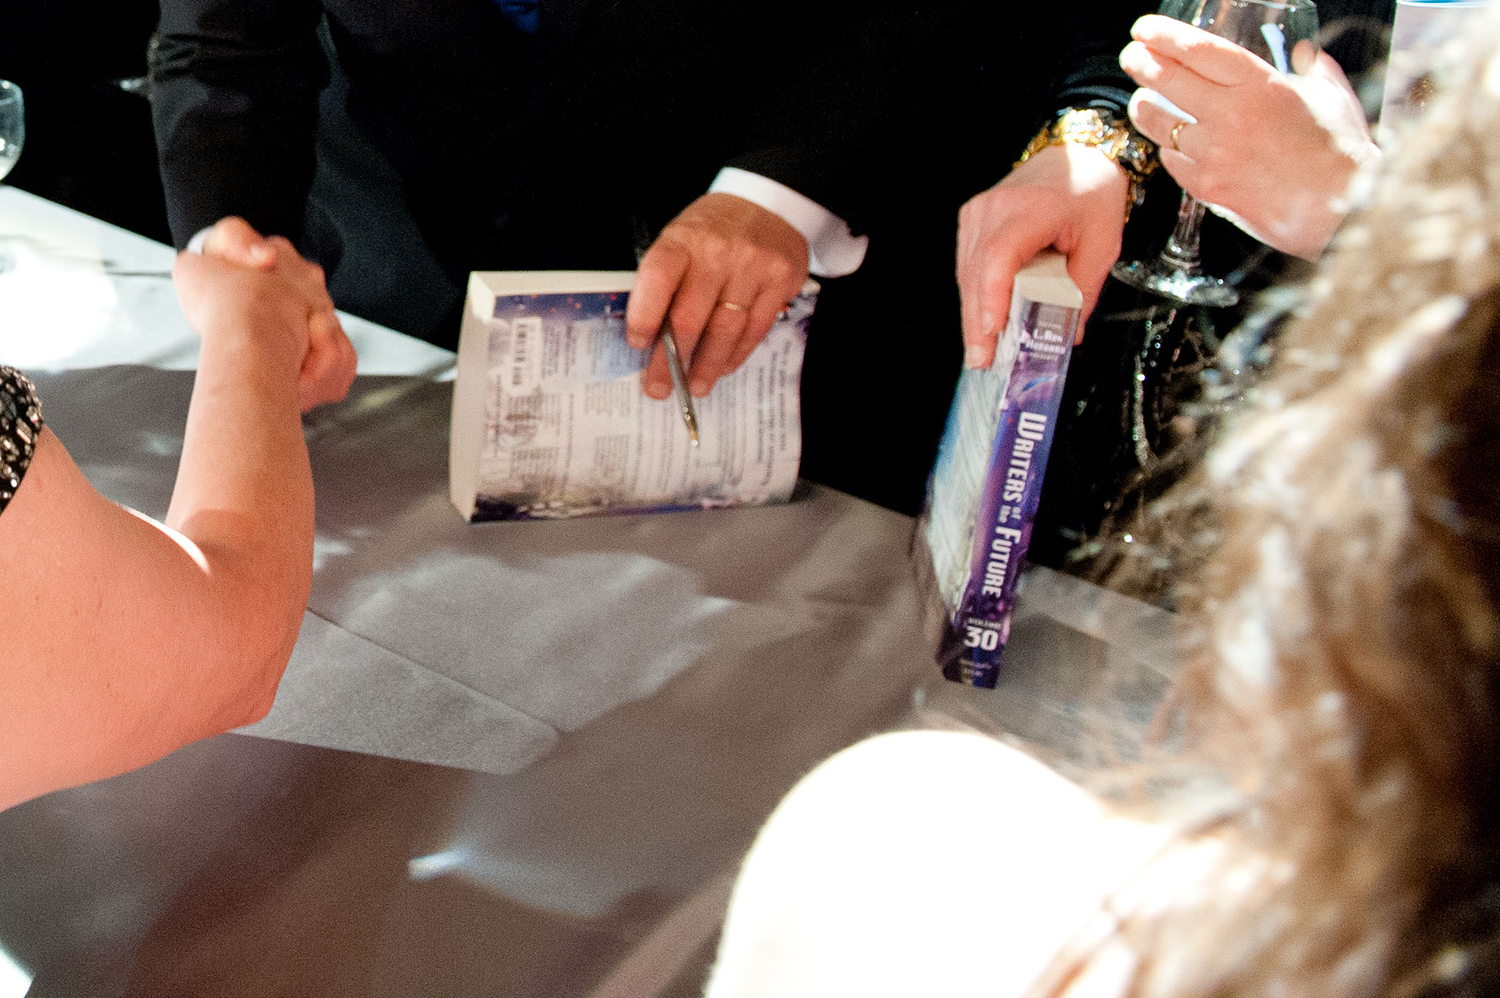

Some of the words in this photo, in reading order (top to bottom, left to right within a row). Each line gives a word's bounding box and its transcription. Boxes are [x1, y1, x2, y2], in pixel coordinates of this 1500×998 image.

[1003, 411, 1048, 503] WRITERS
[981, 525, 1022, 599] FUTURE
[964, 626, 999, 651] 30
